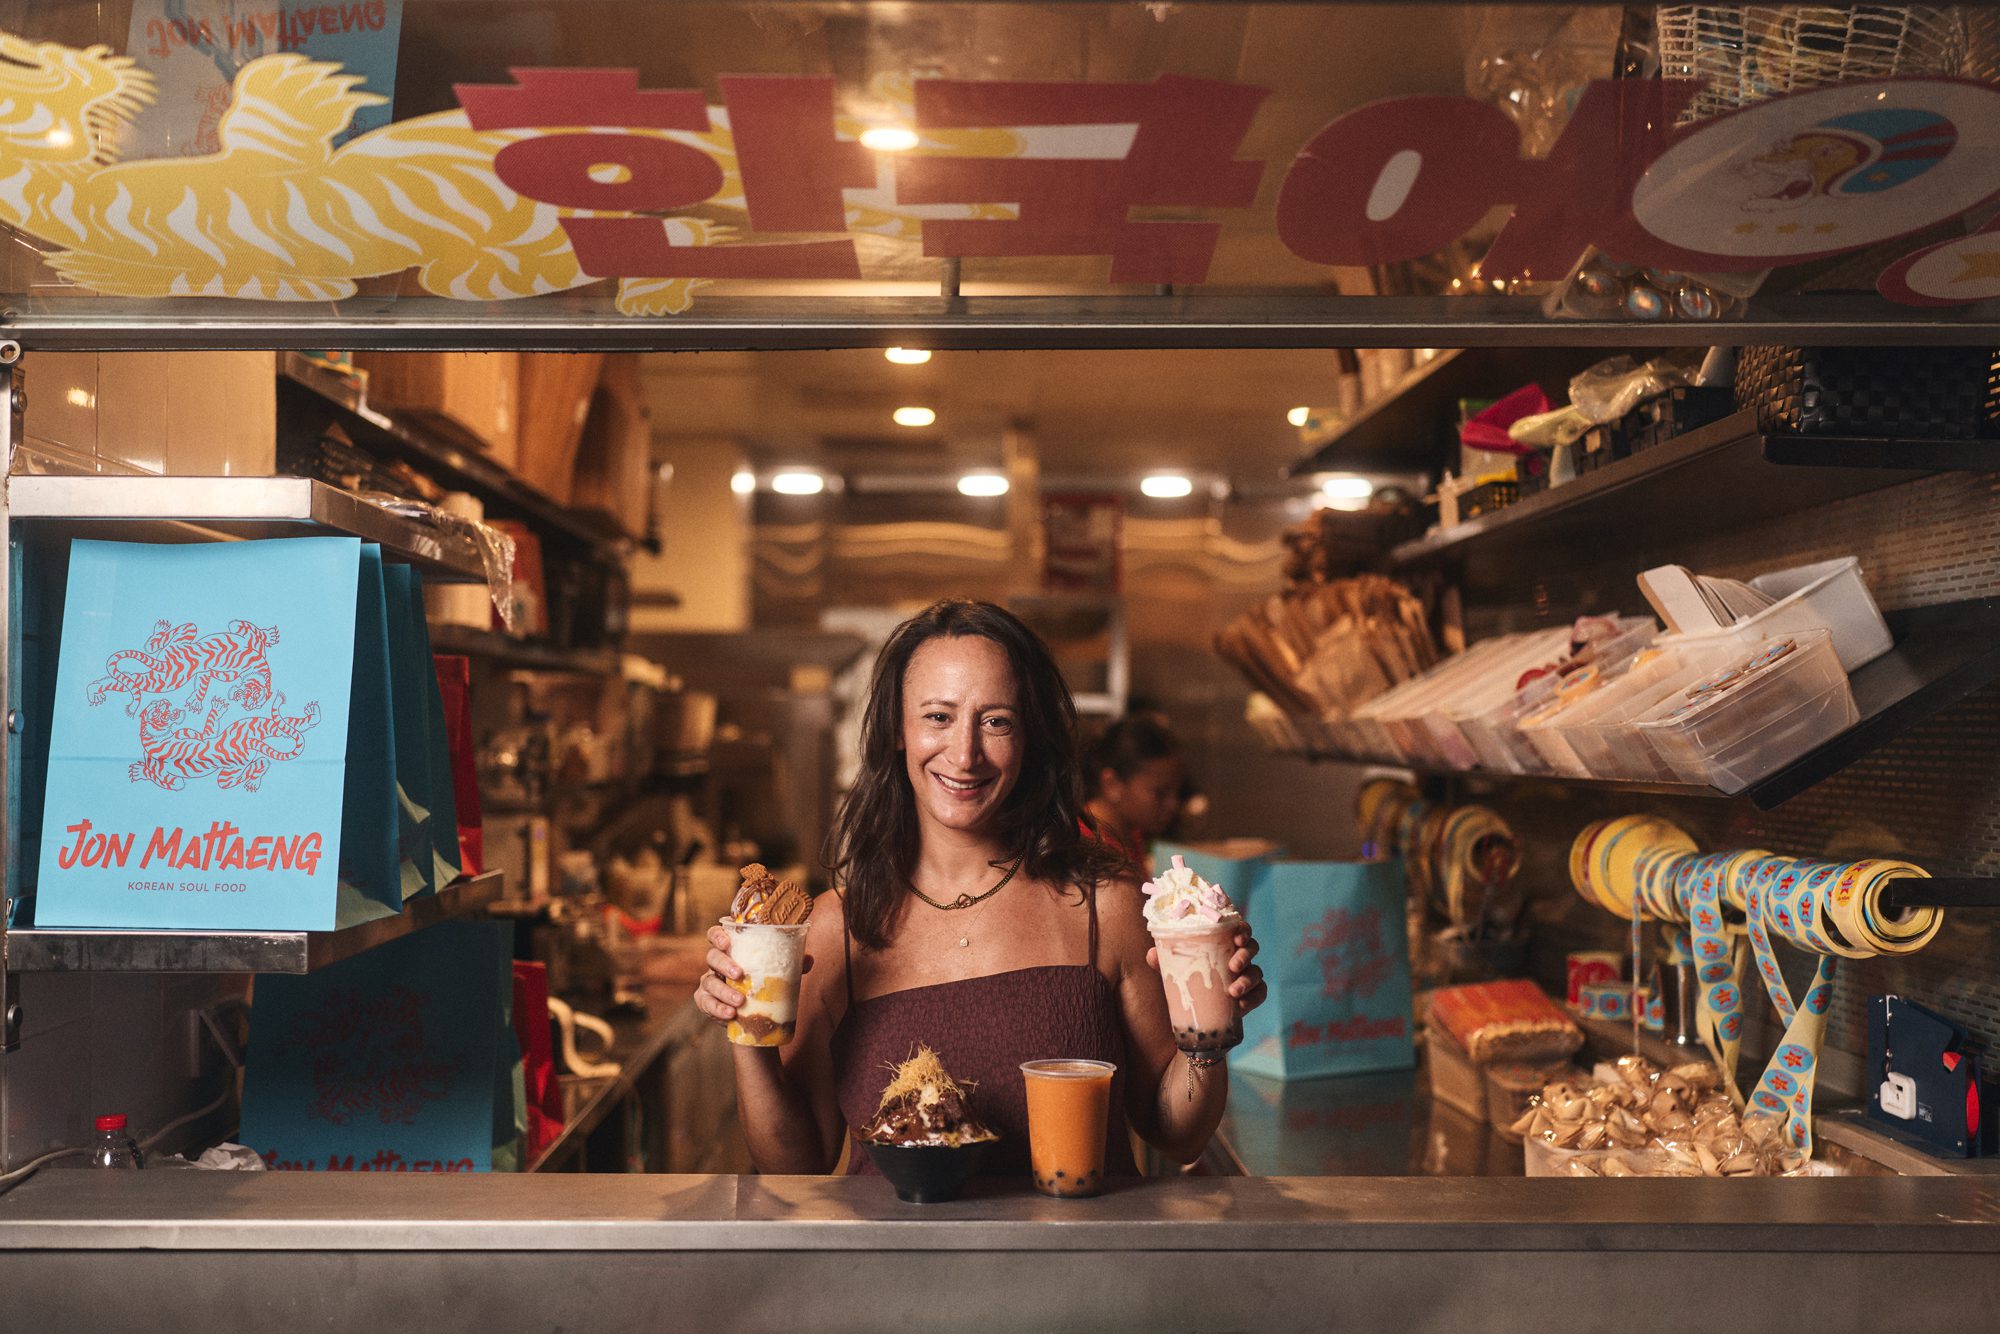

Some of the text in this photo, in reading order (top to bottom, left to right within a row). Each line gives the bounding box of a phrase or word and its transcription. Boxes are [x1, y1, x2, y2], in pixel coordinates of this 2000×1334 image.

[58, 818, 136, 870] JON
[127, 881, 247, 893] KOREAN SOUL FOOD
